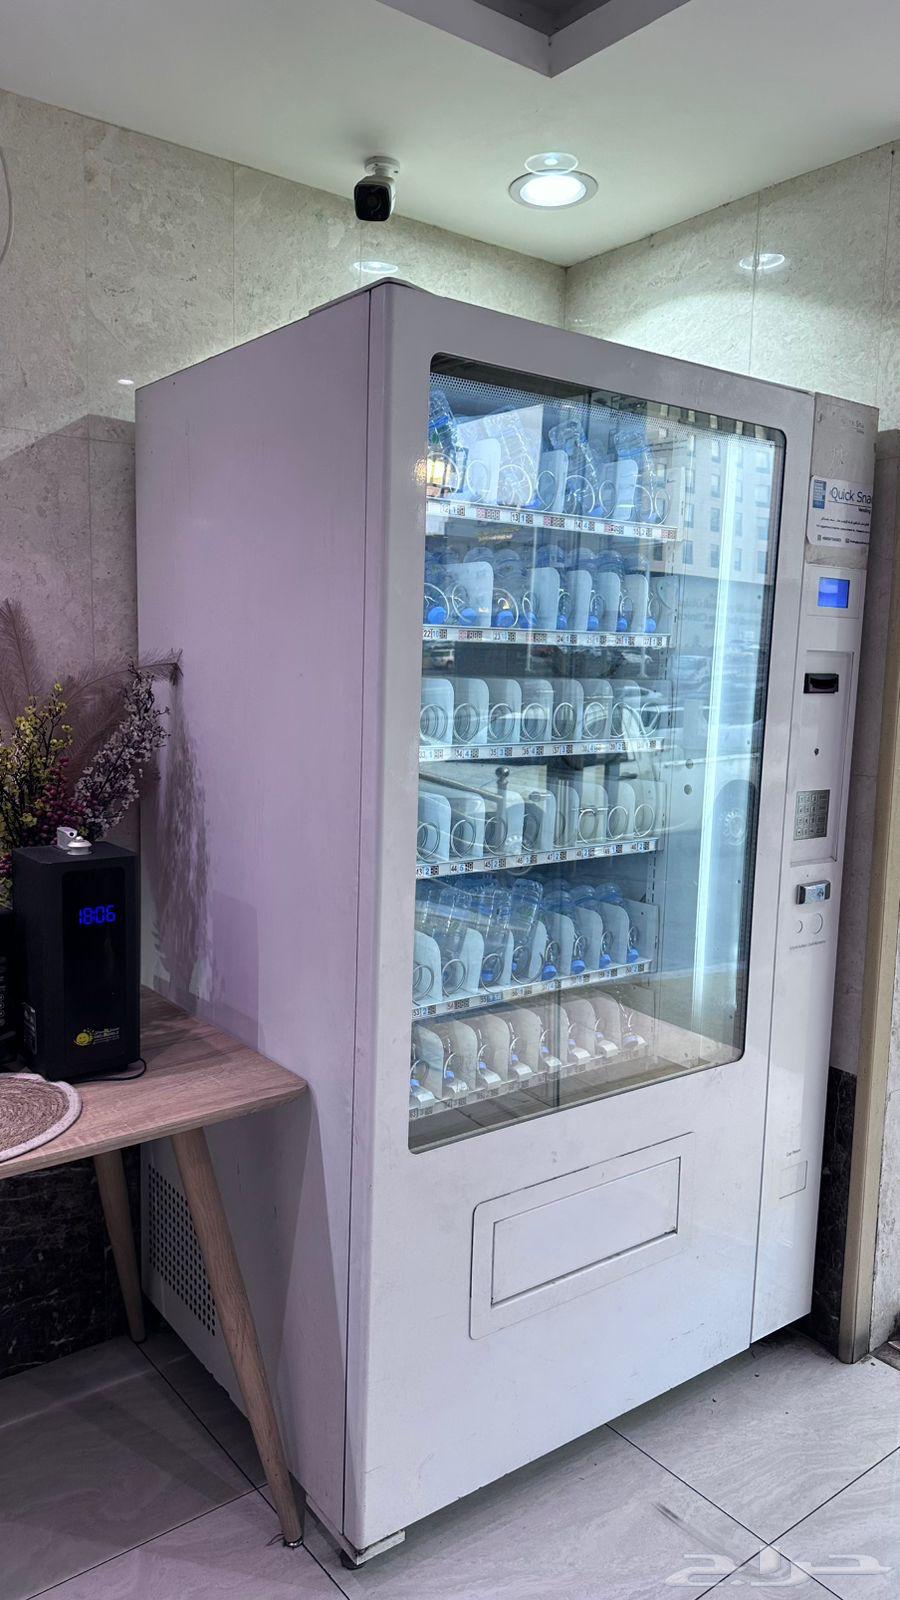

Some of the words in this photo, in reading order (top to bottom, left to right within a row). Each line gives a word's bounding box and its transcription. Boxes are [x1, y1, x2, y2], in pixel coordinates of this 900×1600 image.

[831, 486, 855, 502] Quick
[423, 629, 431, 638] 22
[79, 904, 117, 925] 18:06
